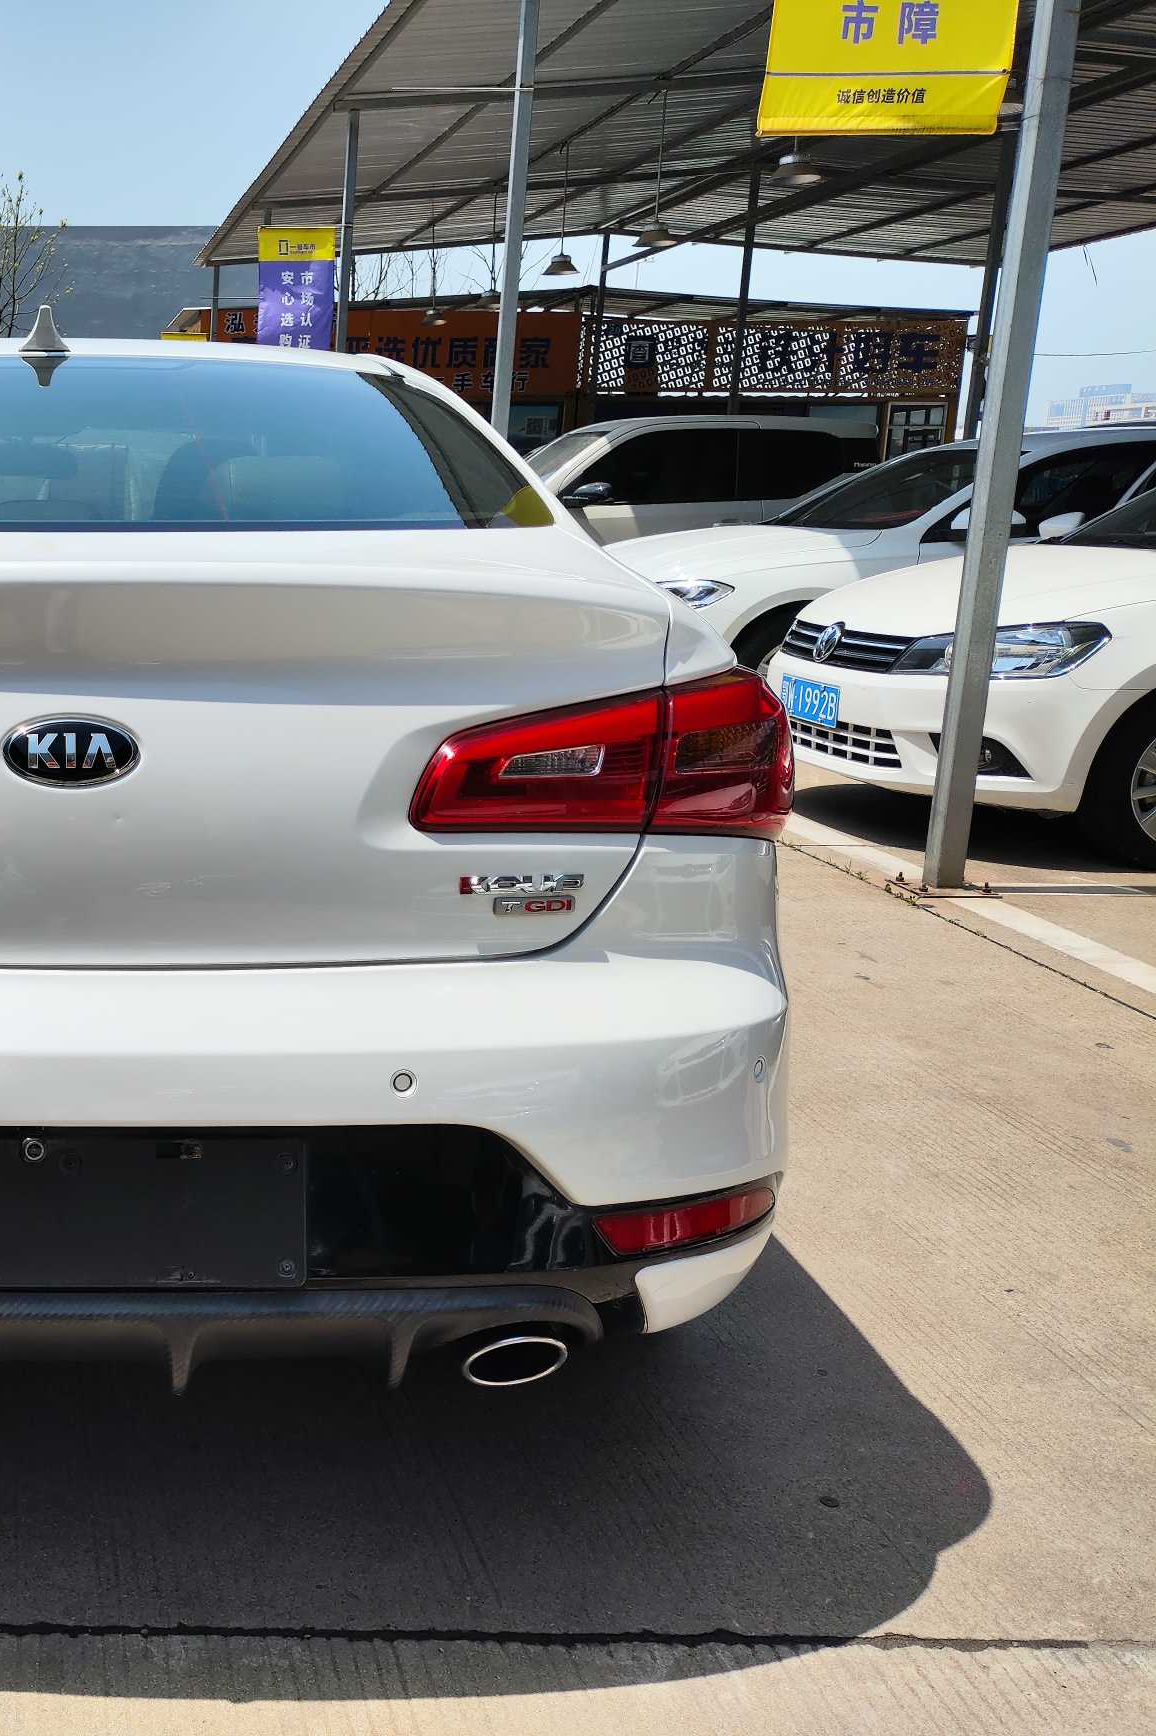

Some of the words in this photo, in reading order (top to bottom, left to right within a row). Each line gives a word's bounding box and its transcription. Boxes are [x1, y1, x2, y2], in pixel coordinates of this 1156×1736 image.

[841, 0, 879, 44] 市
[897, 1, 939, 45] 障
[836, 88, 927, 104] 诚信创造价值
[298, 271, 315, 349] 市场认证
[27, 733, 116, 769] KIA
